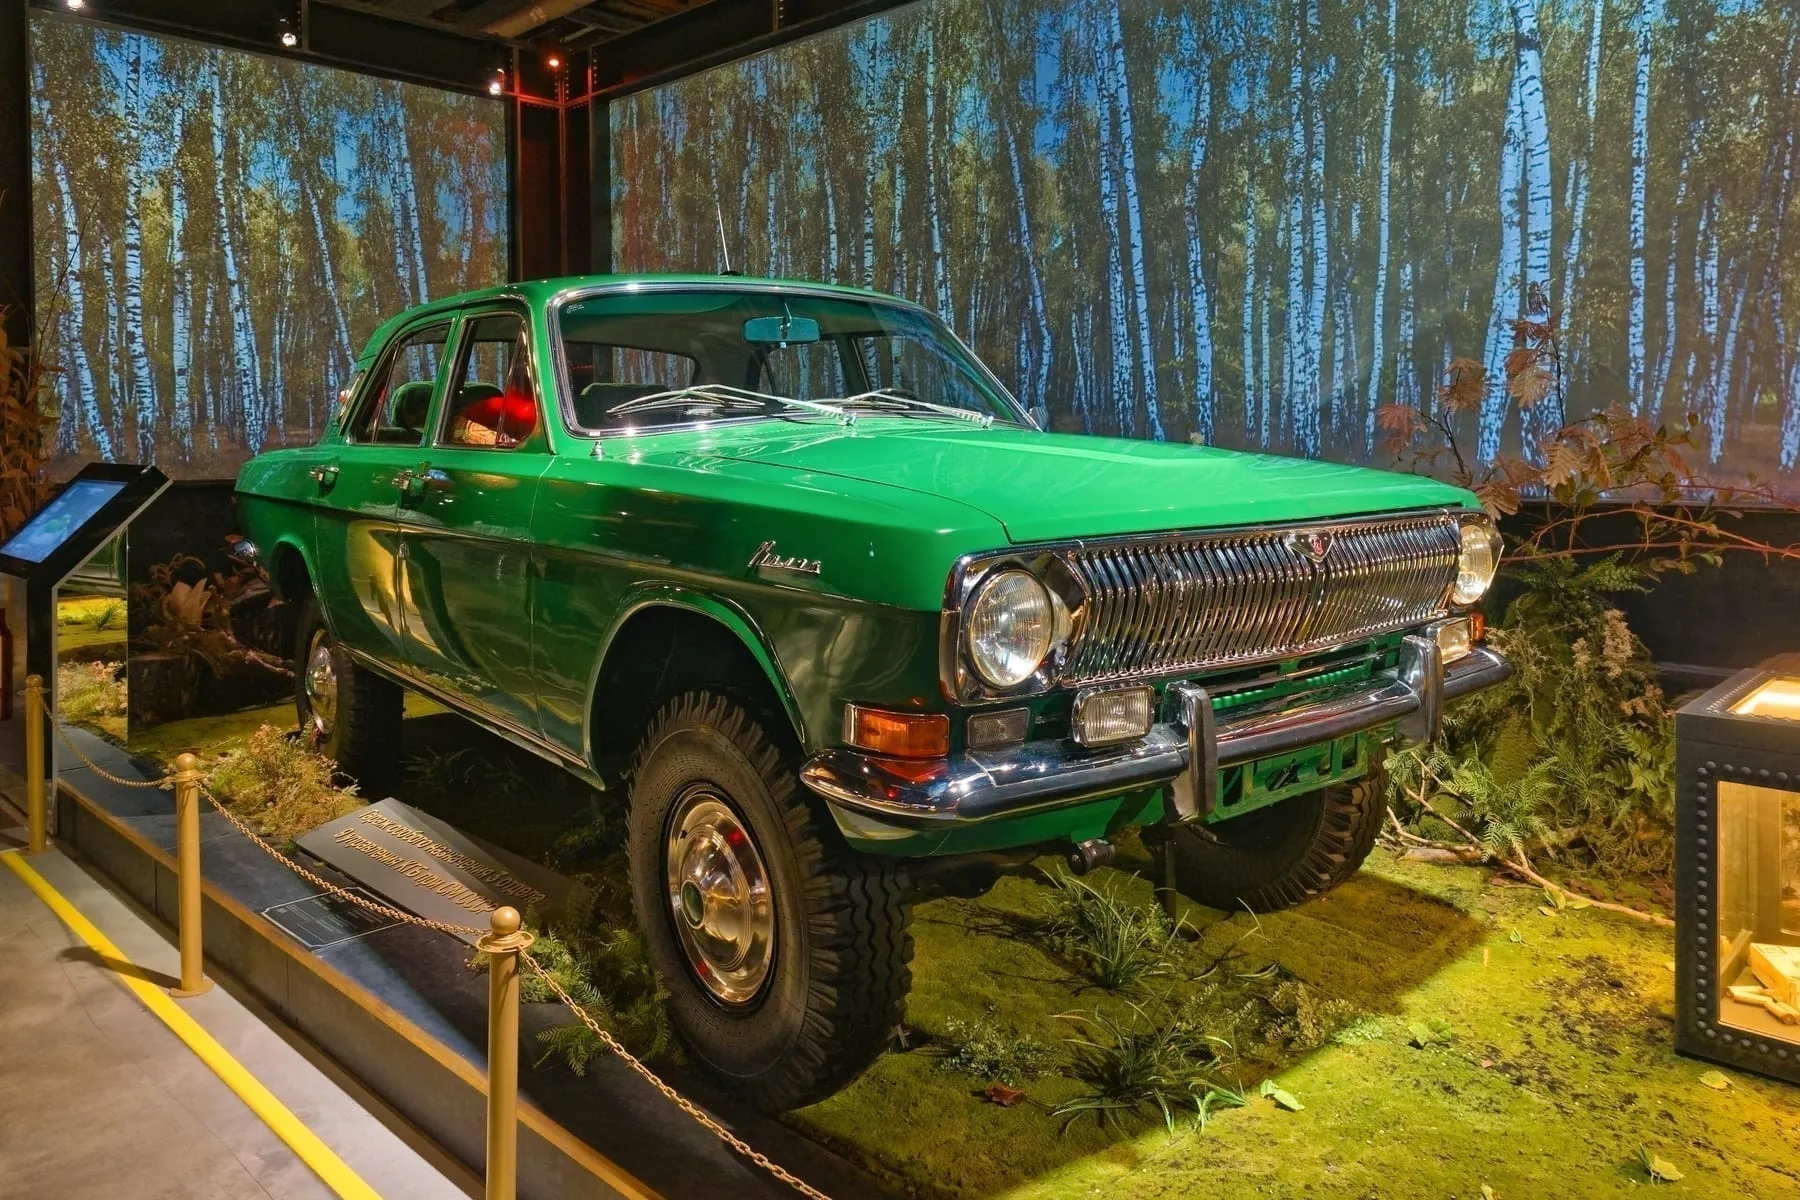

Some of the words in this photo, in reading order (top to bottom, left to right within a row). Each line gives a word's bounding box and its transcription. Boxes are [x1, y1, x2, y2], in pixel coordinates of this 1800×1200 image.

[359, 809, 394, 831] Гараж
[386, 825, 433, 848] особого
[334, 827, 354, 839] 9
[396, 859, 429, 878] КГБ
[414, 872, 446, 890] при
[436, 881, 469, 899] СМ
[455, 891, 498, 914] СССР
[424, 843, 493, 879] назначения
[487, 869, 507, 883] 3
[495, 877, 547, 904] отдела
